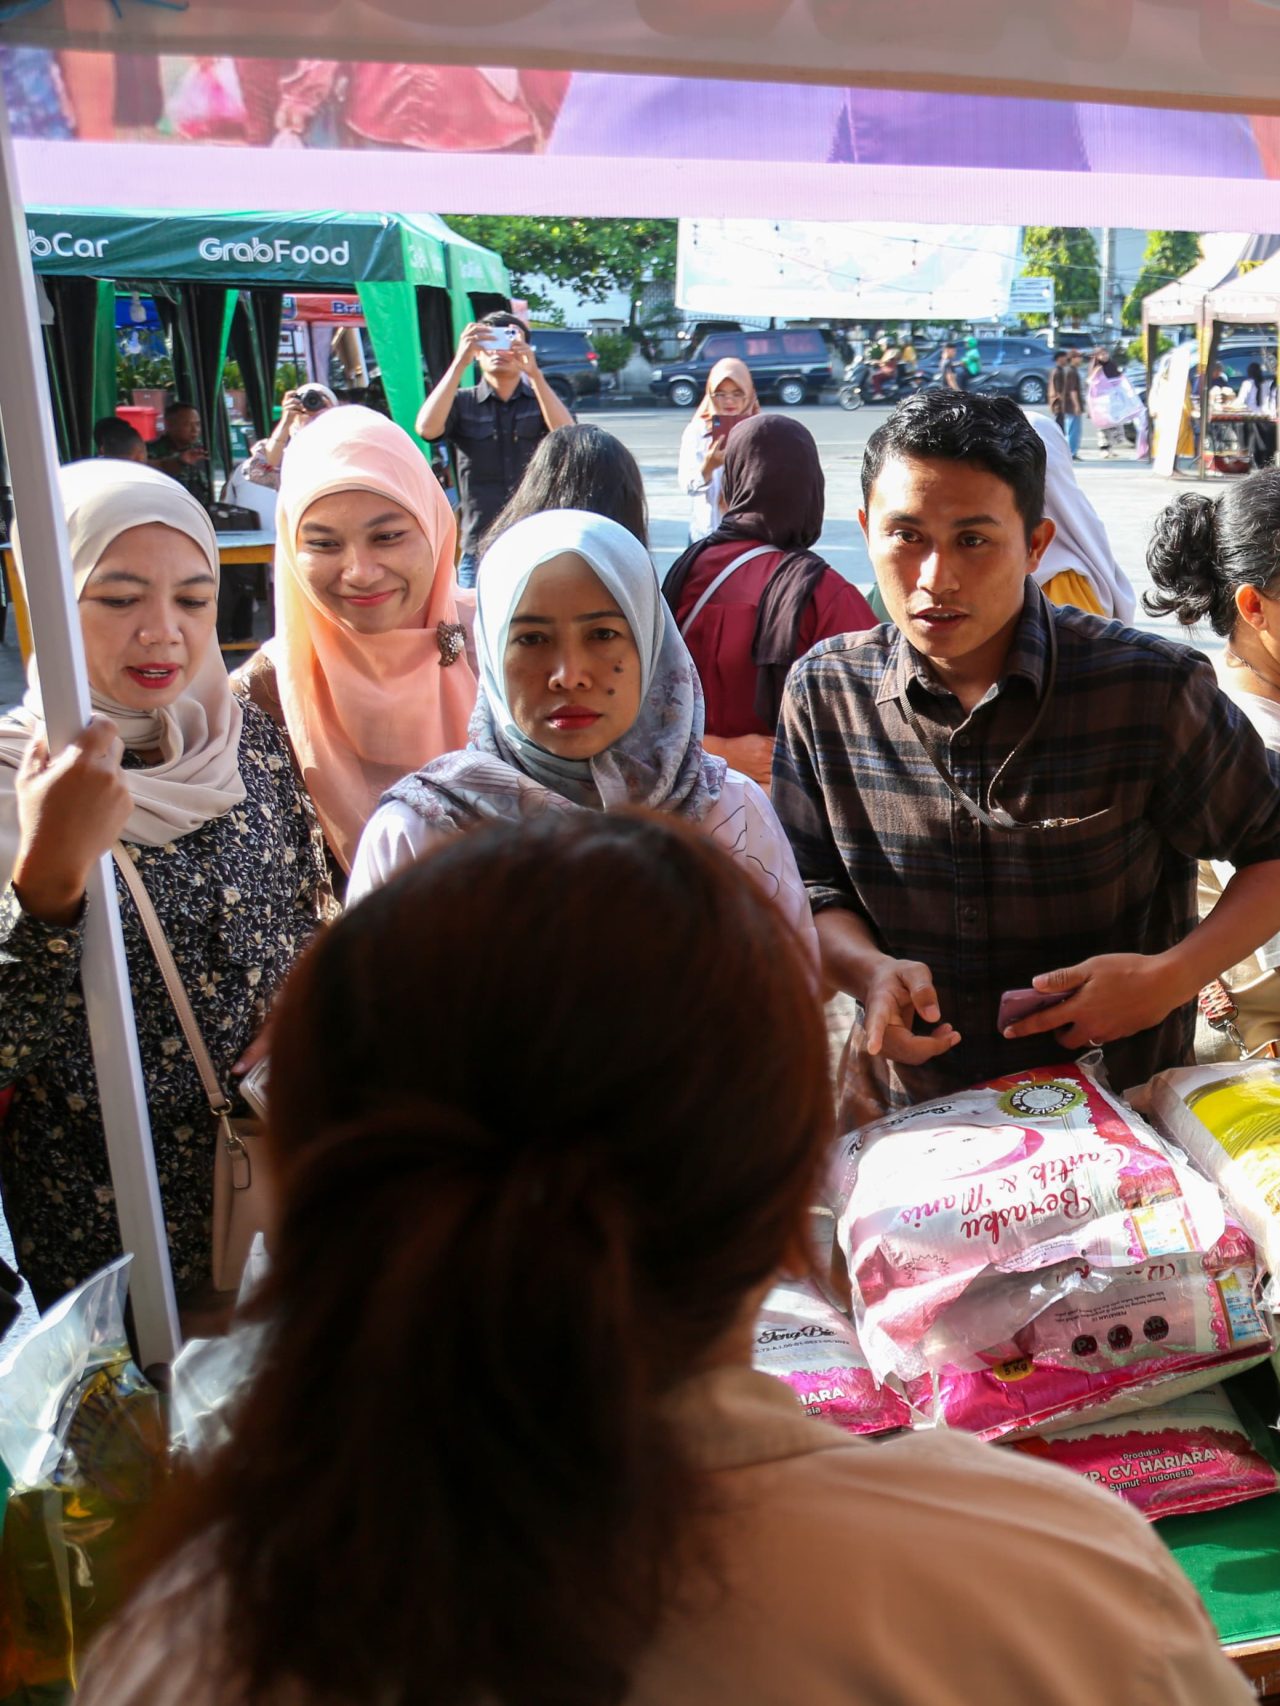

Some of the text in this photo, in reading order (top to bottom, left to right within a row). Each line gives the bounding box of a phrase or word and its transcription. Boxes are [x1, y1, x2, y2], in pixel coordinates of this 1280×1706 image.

[199, 237, 350, 266] GrabFood
[899, 1184, 991, 1228] Manis
[960, 1187, 1093, 1244] Berasku
[1109, 1464, 1138, 1480] CV.
[1140, 1449, 1216, 1474] HARIARA
[1122, 1449, 1161, 1461] Produksi
[1109, 1478, 1141, 1493] Sumut
[1148, 1469, 1194, 1484] Indonesia
